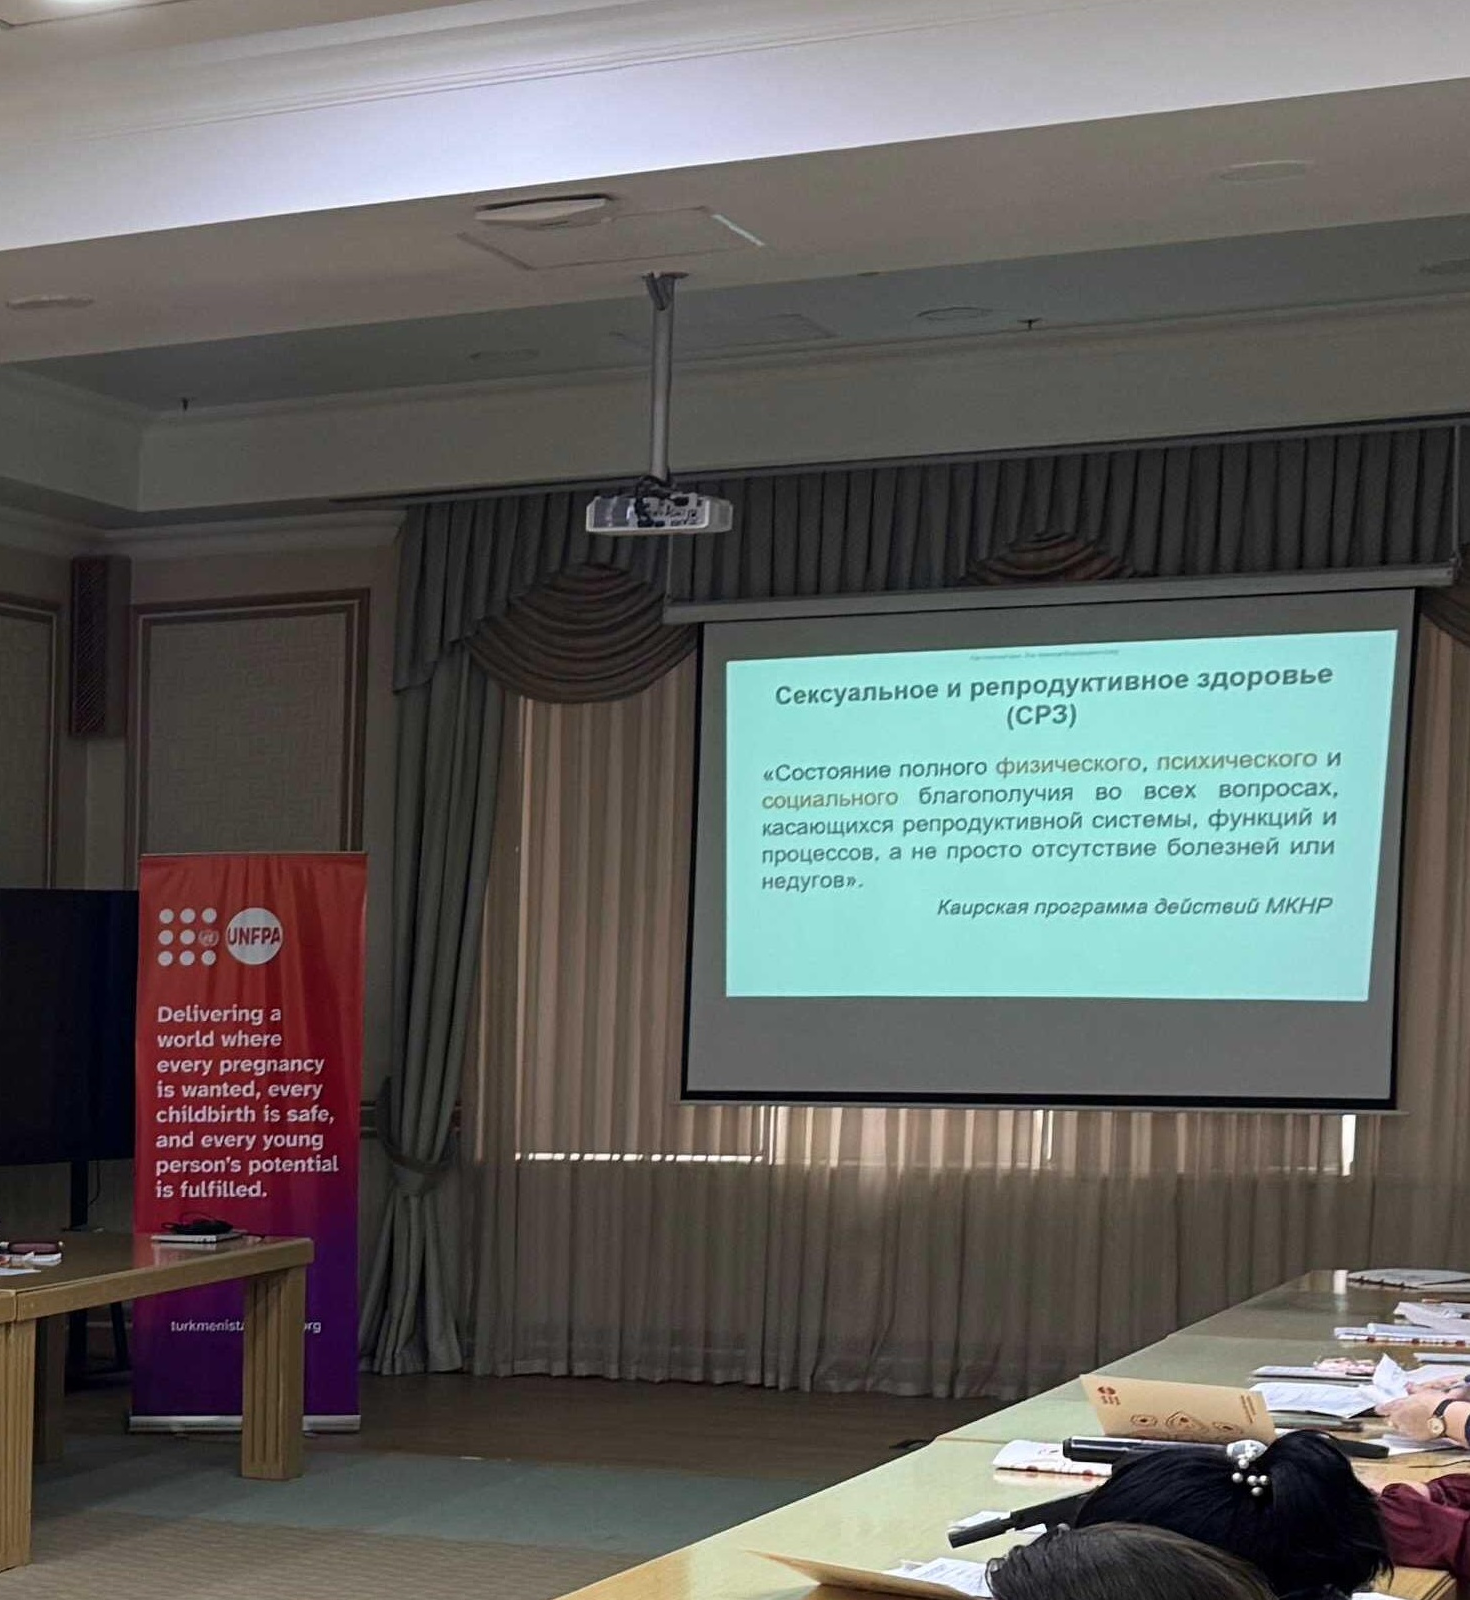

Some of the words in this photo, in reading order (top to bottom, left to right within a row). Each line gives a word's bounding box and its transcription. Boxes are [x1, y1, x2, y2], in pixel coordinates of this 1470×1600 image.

[775, 682, 939, 707] Сексуальное
[947, 682, 961, 698] и
[970, 674, 1189, 701] репродуктивное
[1197, 667, 1333, 691] здоровье
[763, 764, 891, 782] «Состояние
[899, 760, 987, 778] полного
[995, 756, 1148, 778] физического,
[1157, 752, 1317, 772] психического
[1327, 751, 1341, 767] и
[762, 790, 899, 811] социального
[918, 785, 1074, 807] благополучия
[1095, 786, 1122, 800] во
[1144, 784, 1196, 799] всех
[1219, 781, 1338, 802] вопросах,
[762, 819, 894, 837] касающихся
[902, 811, 1083, 837] репродуктивной
[1092, 812, 1198, 830] системы,
[1209, 808, 1312, 831] функций
[1323, 810, 1337, 826] и
[889, 846, 902, 861] а
[911, 845, 937, 860] не
[946, 842, 1022, 863] просто
[1032, 841, 1157, 862] отсутствие
[1167, 838, 1279, 857] болезней
[1290, 839, 1335, 856] или
[762, 874, 864, 893] недугов».
[936, 899, 1028, 918] Каирская
[1033, 900, 1148, 918] программа
[1154, 897, 1259, 915] действий
[1264, 897, 1333, 915] МКНР
[228, 926, 281, 945] UNFPA
[157, 1004, 264, 1026] Delivering
[269, 1007, 282, 1022] a
[157, 1030, 214, 1048] world
[220, 1030, 282, 1047] where
[156, 1058, 213, 1076] every
[219, 1058, 325, 1076] pregnancy
[156, 1080, 175, 1098] is
[181, 1080, 261, 1100] wanted,
[268, 1083, 323, 1100] every
[155, 1104, 256, 1123] childbirth
[263, 1104, 281, 1122] is
[286, 1104, 335, 1125] safe,
[155, 1130, 194, 1148] and
[201, 1133, 257, 1151] every
[262, 1133, 324, 1151] young
[155, 1156, 242, 1177] person's
[248, 1154, 339, 1176] potential
[155, 1180, 174, 1198] is
[180, 1179, 268, 1199] fulfilled.
